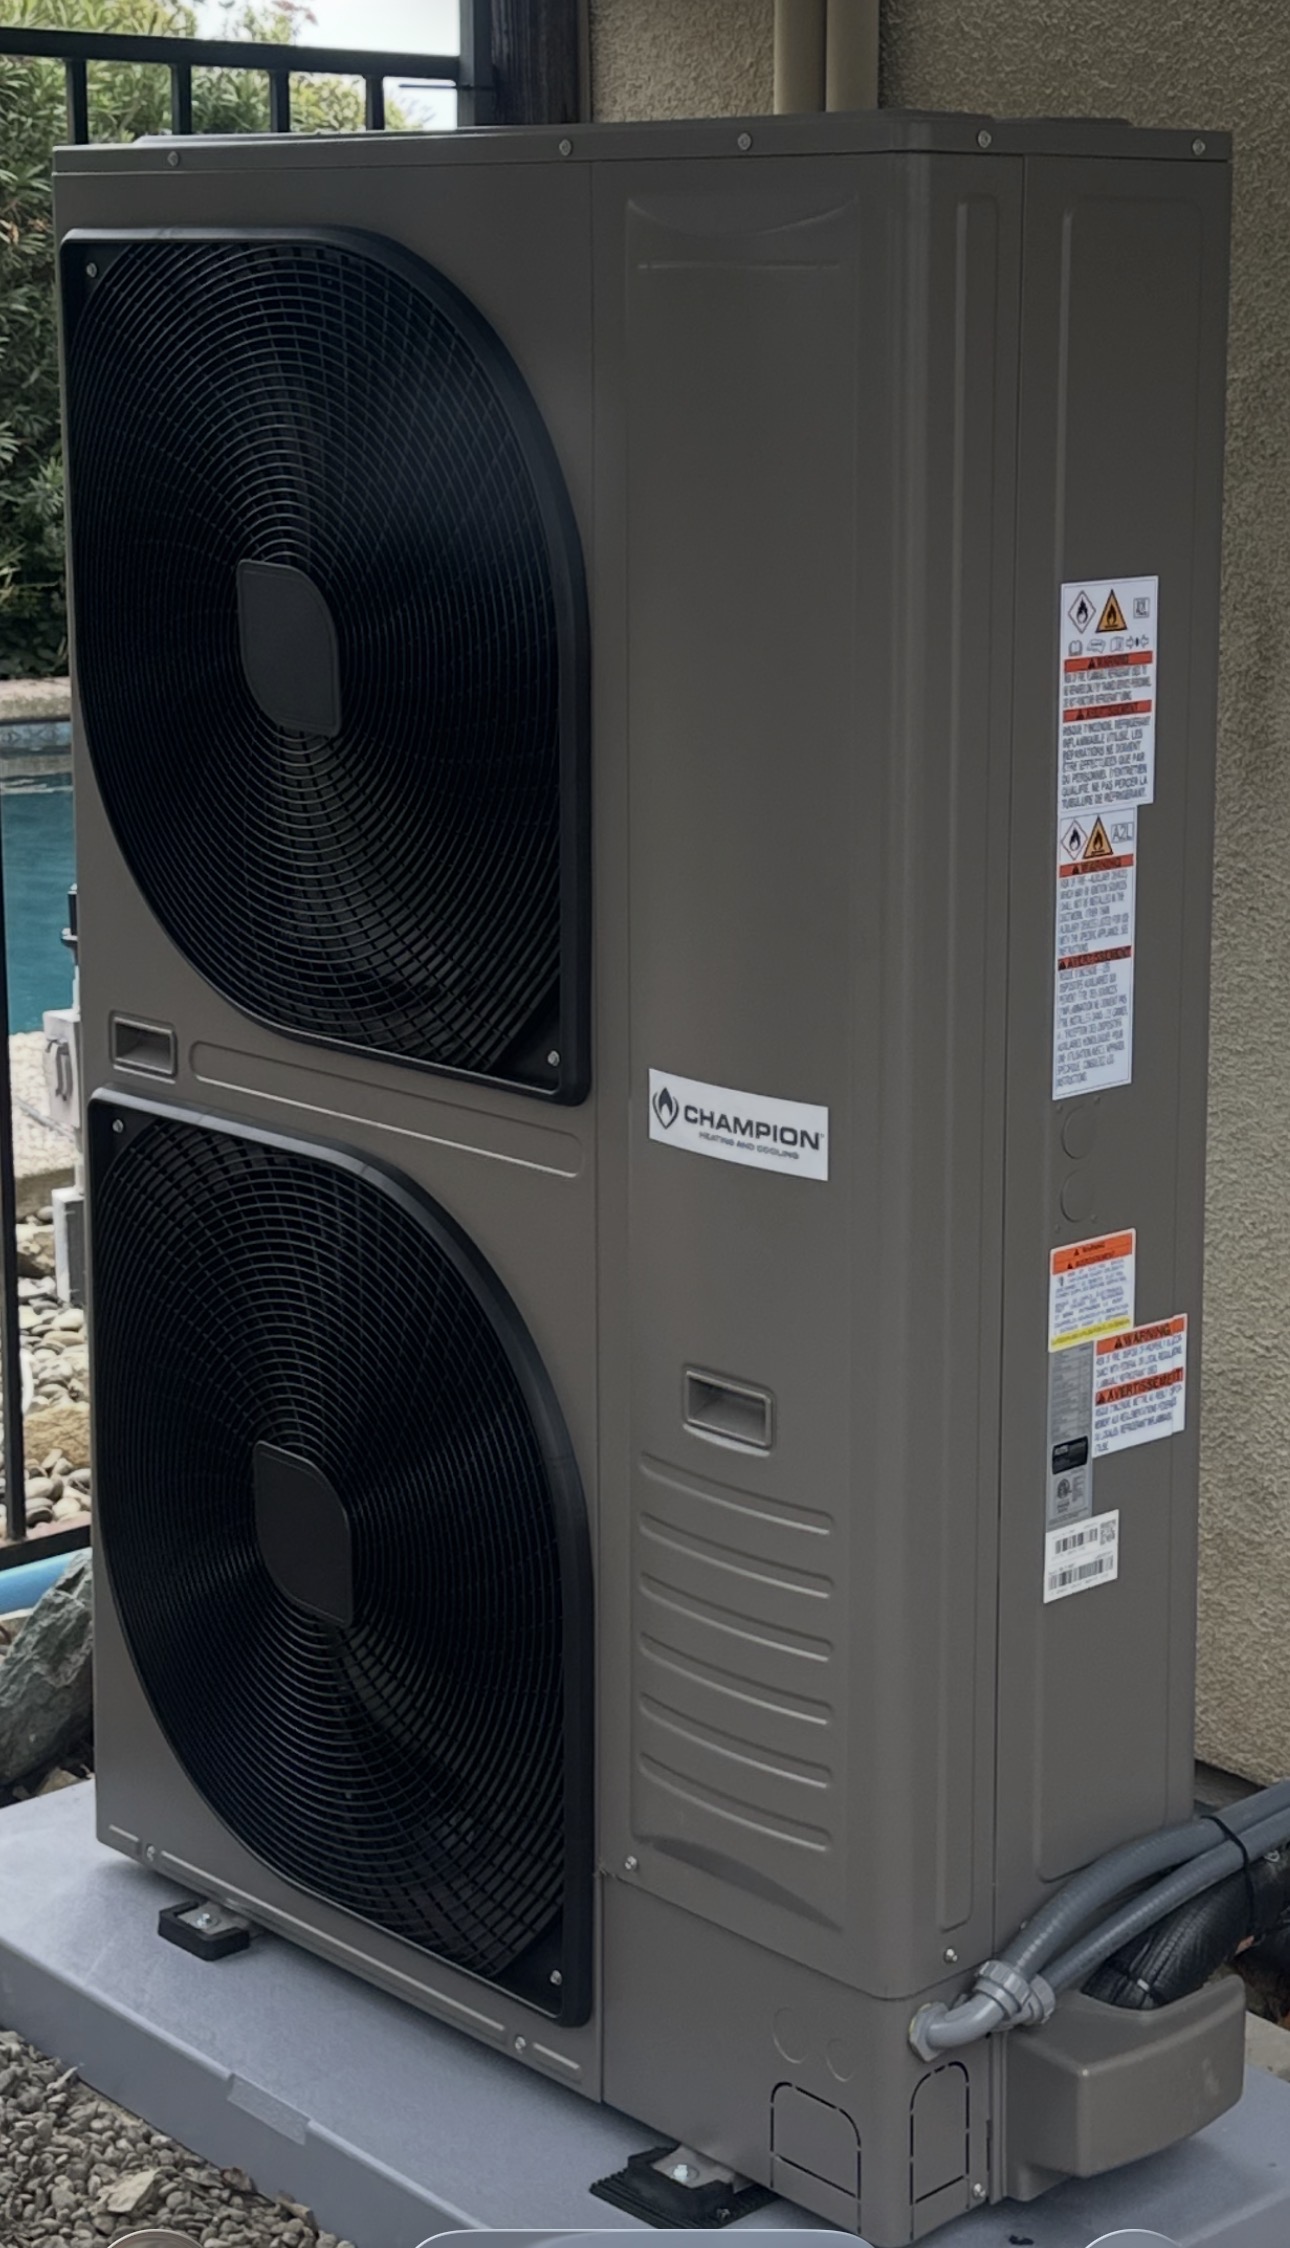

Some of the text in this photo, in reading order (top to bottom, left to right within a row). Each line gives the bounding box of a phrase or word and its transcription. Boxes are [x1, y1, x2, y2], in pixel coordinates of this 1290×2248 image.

[1112, 825, 1133, 842] A2L
[684, 1104, 820, 1151] CHAMPION
[699, 1131, 800, 1160] HEATING AND COOLING
[1121, 1322, 1171, 1347] WARNING
